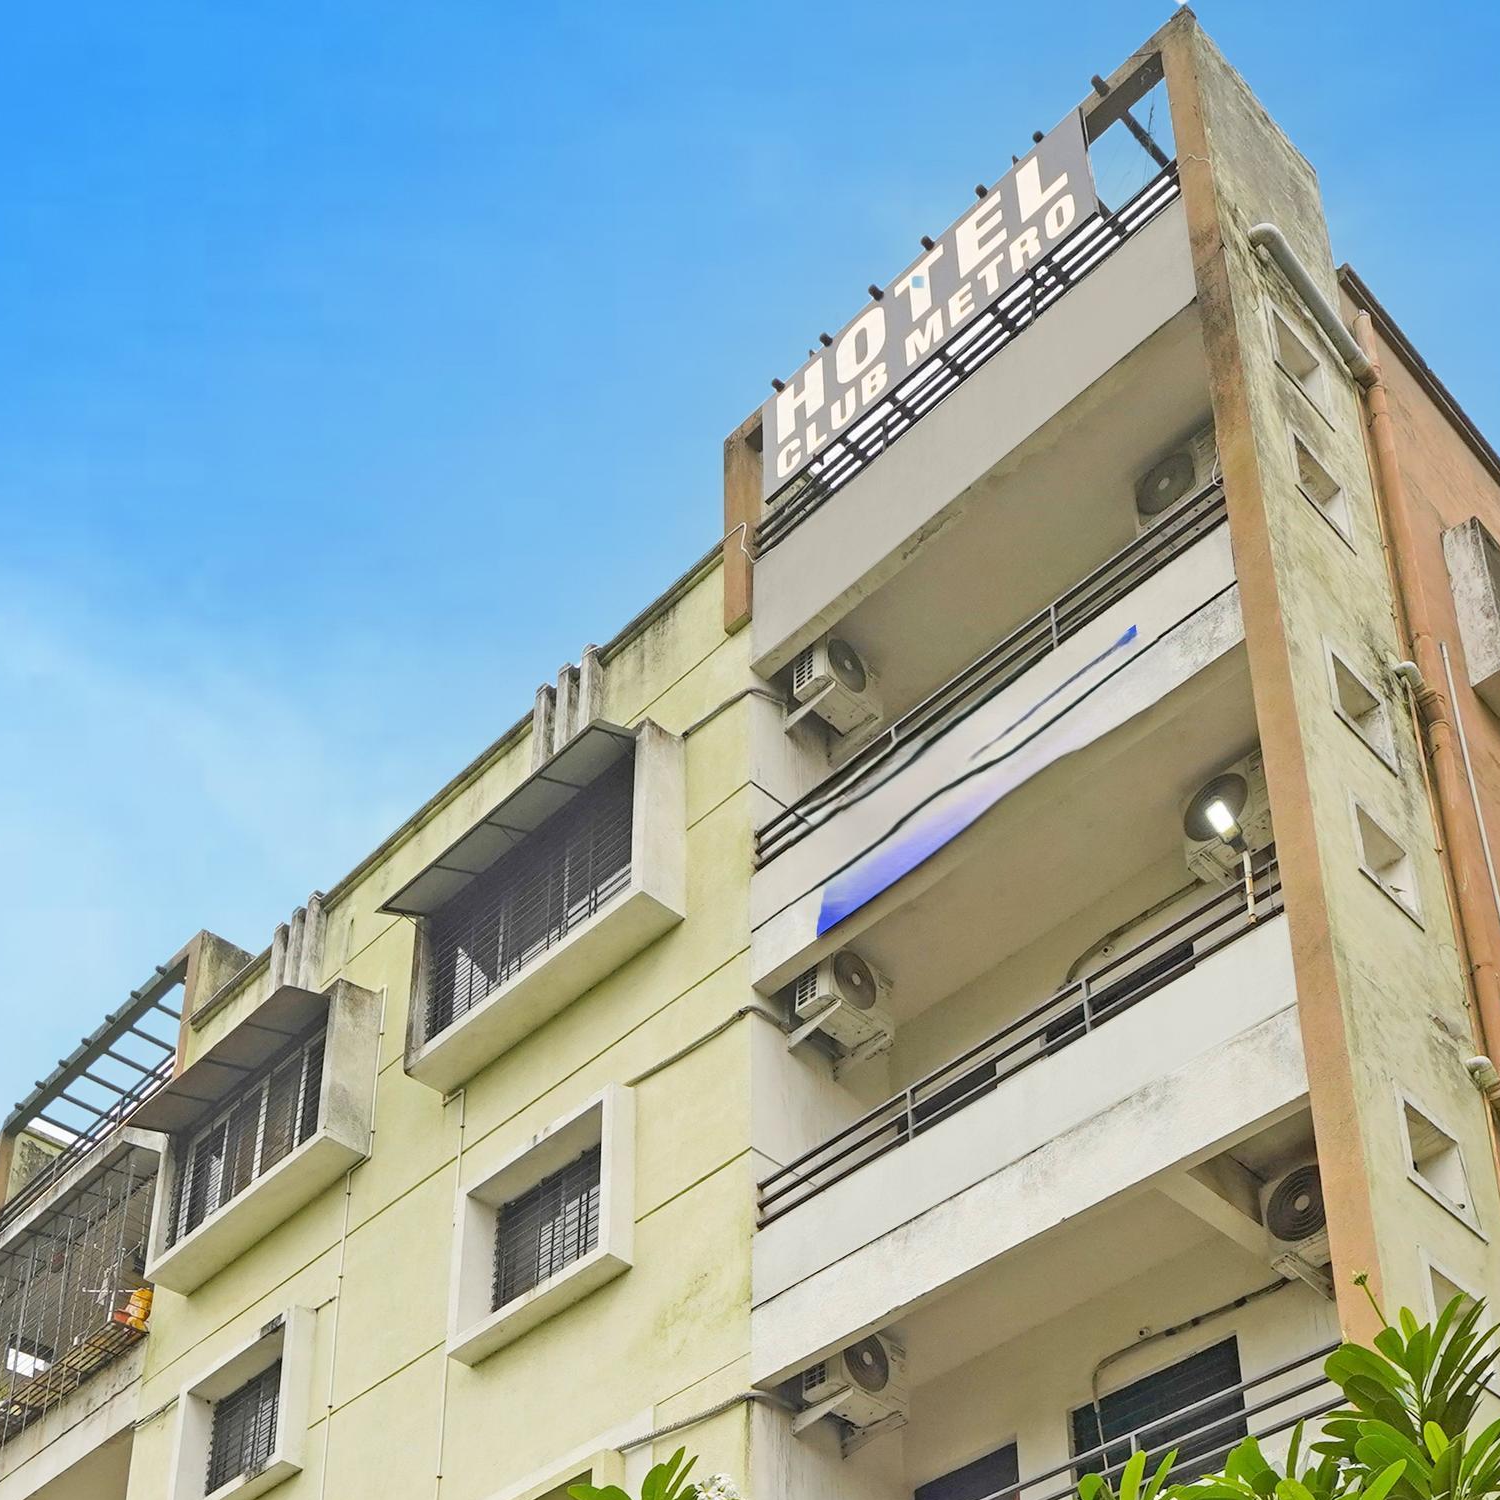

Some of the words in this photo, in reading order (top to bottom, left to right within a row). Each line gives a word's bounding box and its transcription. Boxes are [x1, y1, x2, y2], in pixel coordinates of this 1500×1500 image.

[776, 155, 1069, 444] HOTEL
[776, 363, 888, 478] CLUB
[904, 193, 1076, 367] METRO
